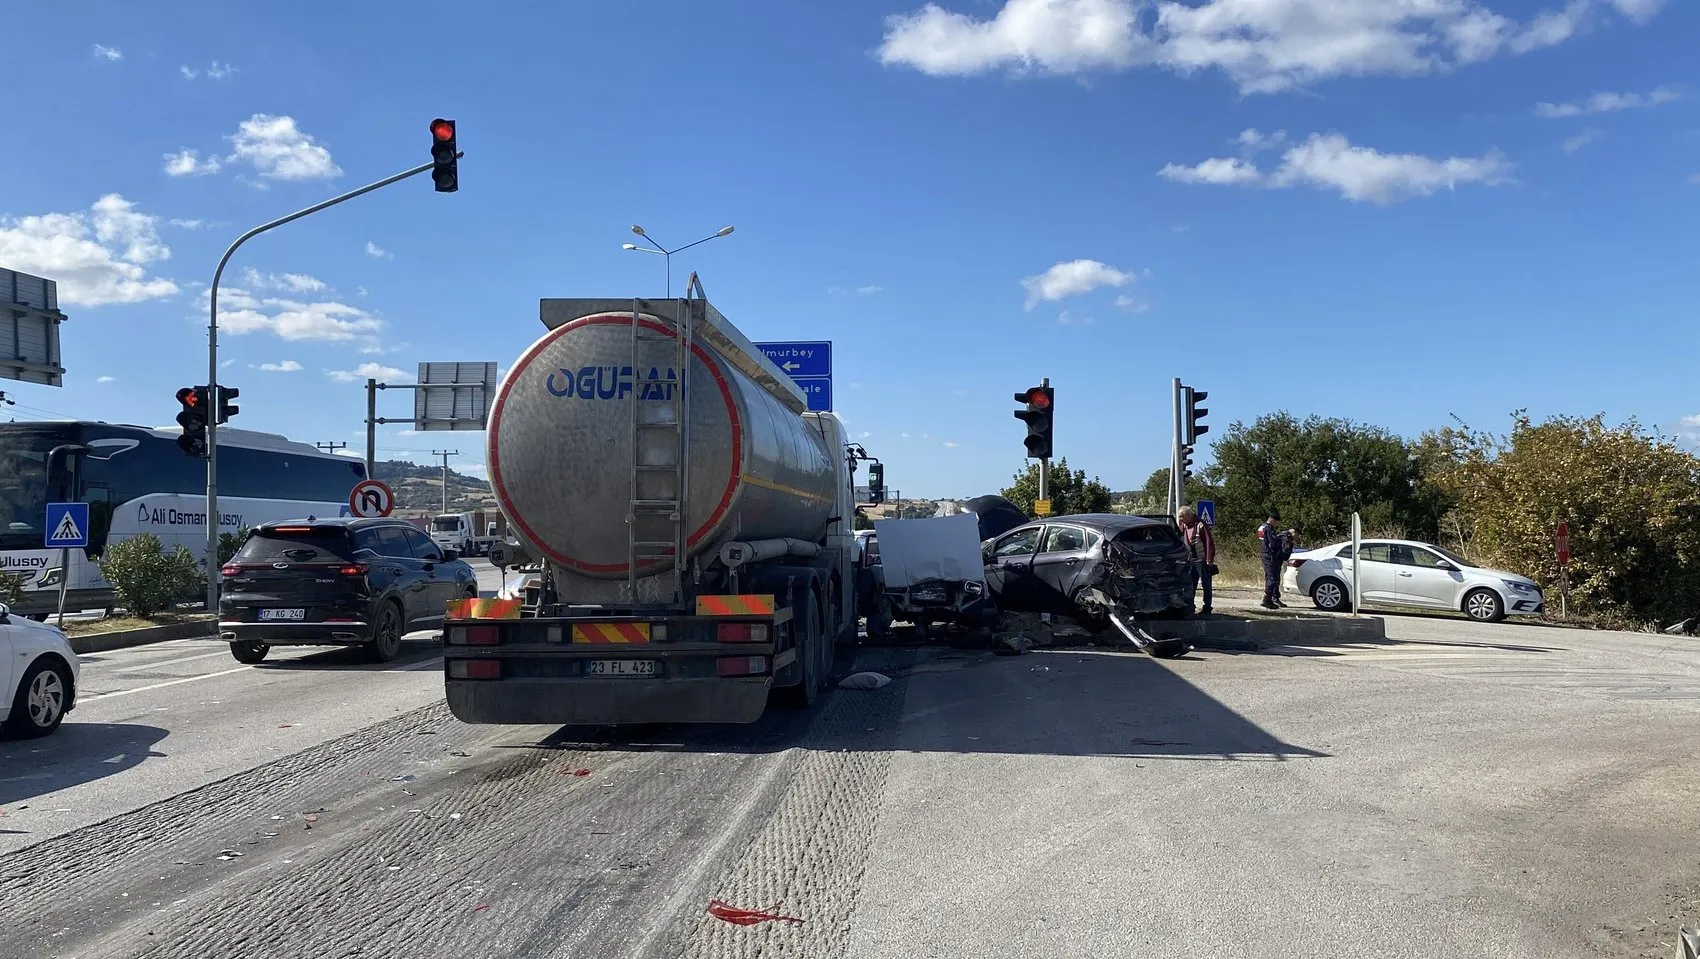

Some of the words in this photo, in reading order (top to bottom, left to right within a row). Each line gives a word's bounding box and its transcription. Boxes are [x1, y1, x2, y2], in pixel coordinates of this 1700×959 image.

[151, 508, 166, 525] Ali
[169, 509, 207, 525] Osman
[216, 510, 242, 528] lusoy
[263, 610, 271, 618] 17
[275, 610, 286, 618] KG
[289, 610, 304, 618] 240
[591, 661, 605, 673] 23
[611, 661, 625, 673] FL
[632, 661, 654, 673] 423
